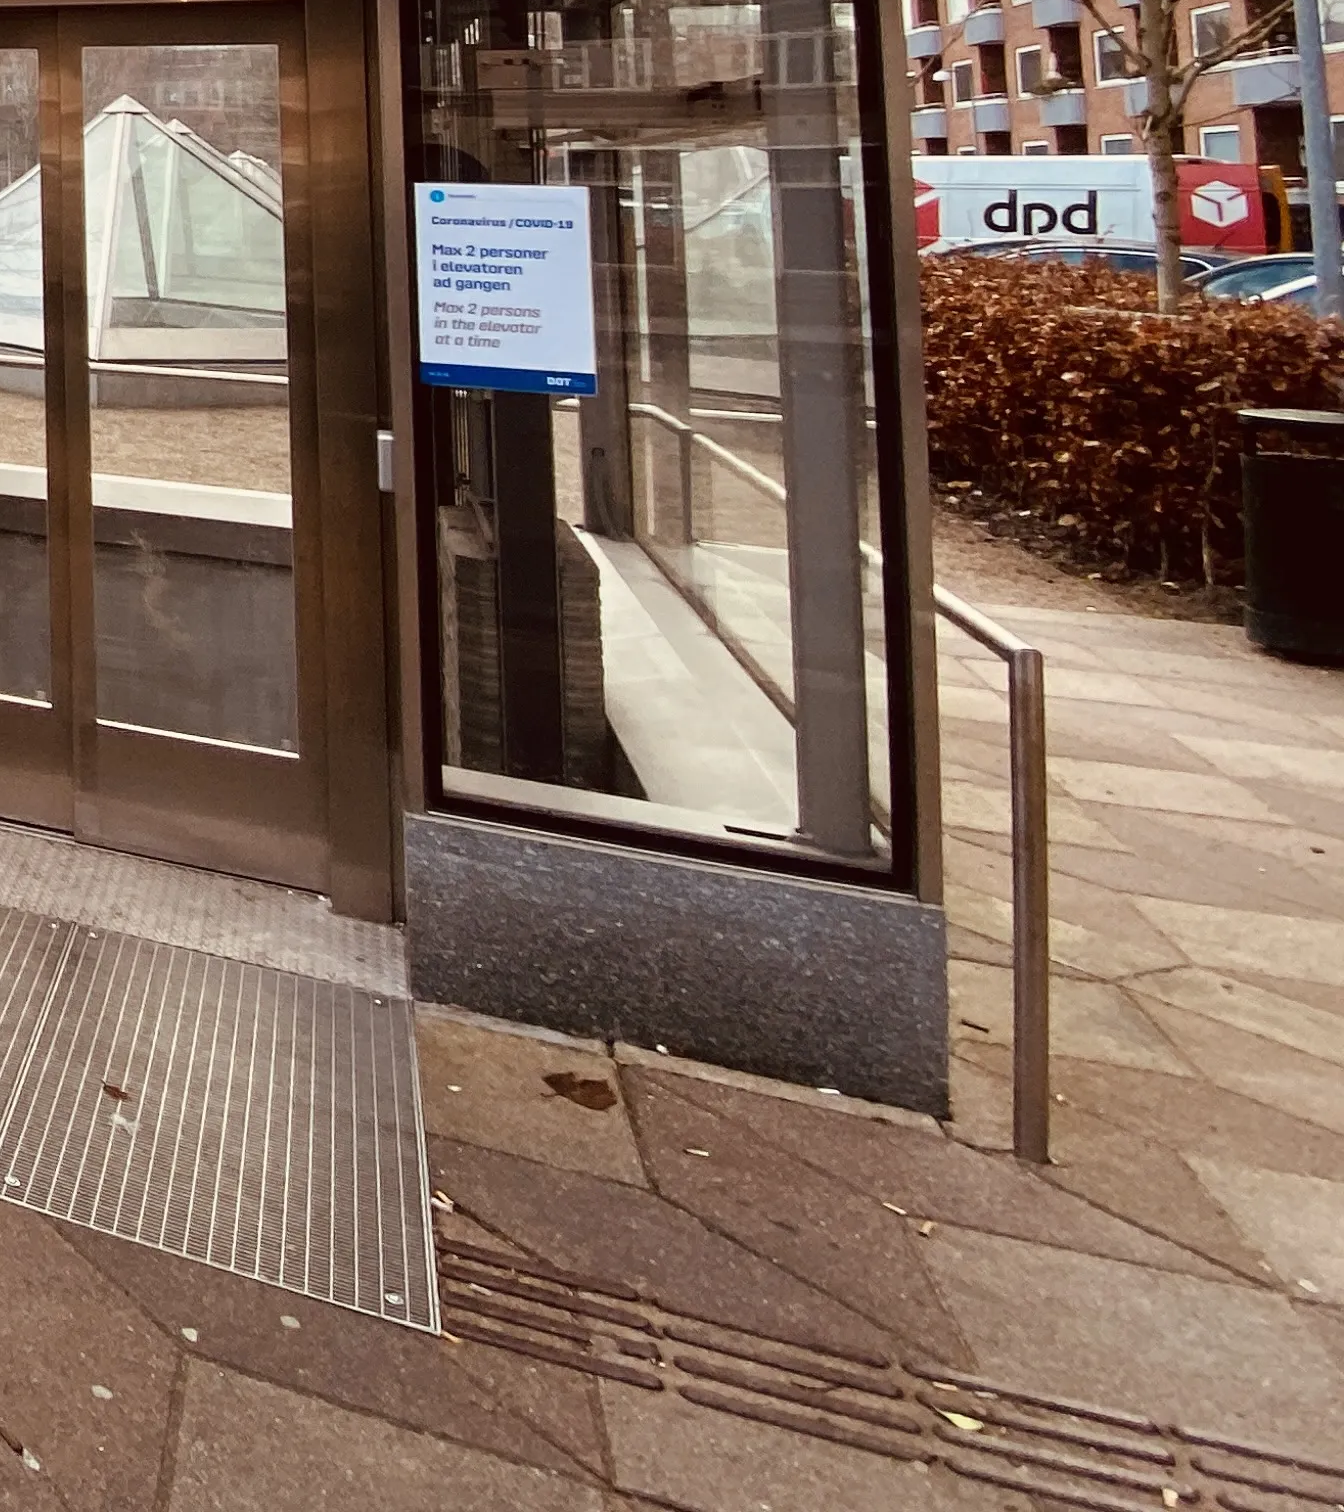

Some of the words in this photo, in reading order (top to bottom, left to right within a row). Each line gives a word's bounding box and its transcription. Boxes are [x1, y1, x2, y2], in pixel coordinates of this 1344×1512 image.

[983, 189, 1097, 235] dpd
[432, 216, 506, 227] Coronavirus
[432, 244, 462, 256] Max
[466, 245, 475, 257] 2
[480, 248, 549, 260] personer
[440, 261, 523, 275] elevatoren
[433, 277, 451, 288] ad
[455, 279, 511, 292] gangen
[434, 301, 464, 314] Max
[467, 303, 477, 315] 2
[480, 306, 541, 318] persons
[434, 317, 447, 329] in
[452, 317, 475, 331] the
[479, 320, 542, 334] elevator
[435, 334, 450, 345] at
[454, 336, 463, 346] a
[468, 335, 501, 348] time
